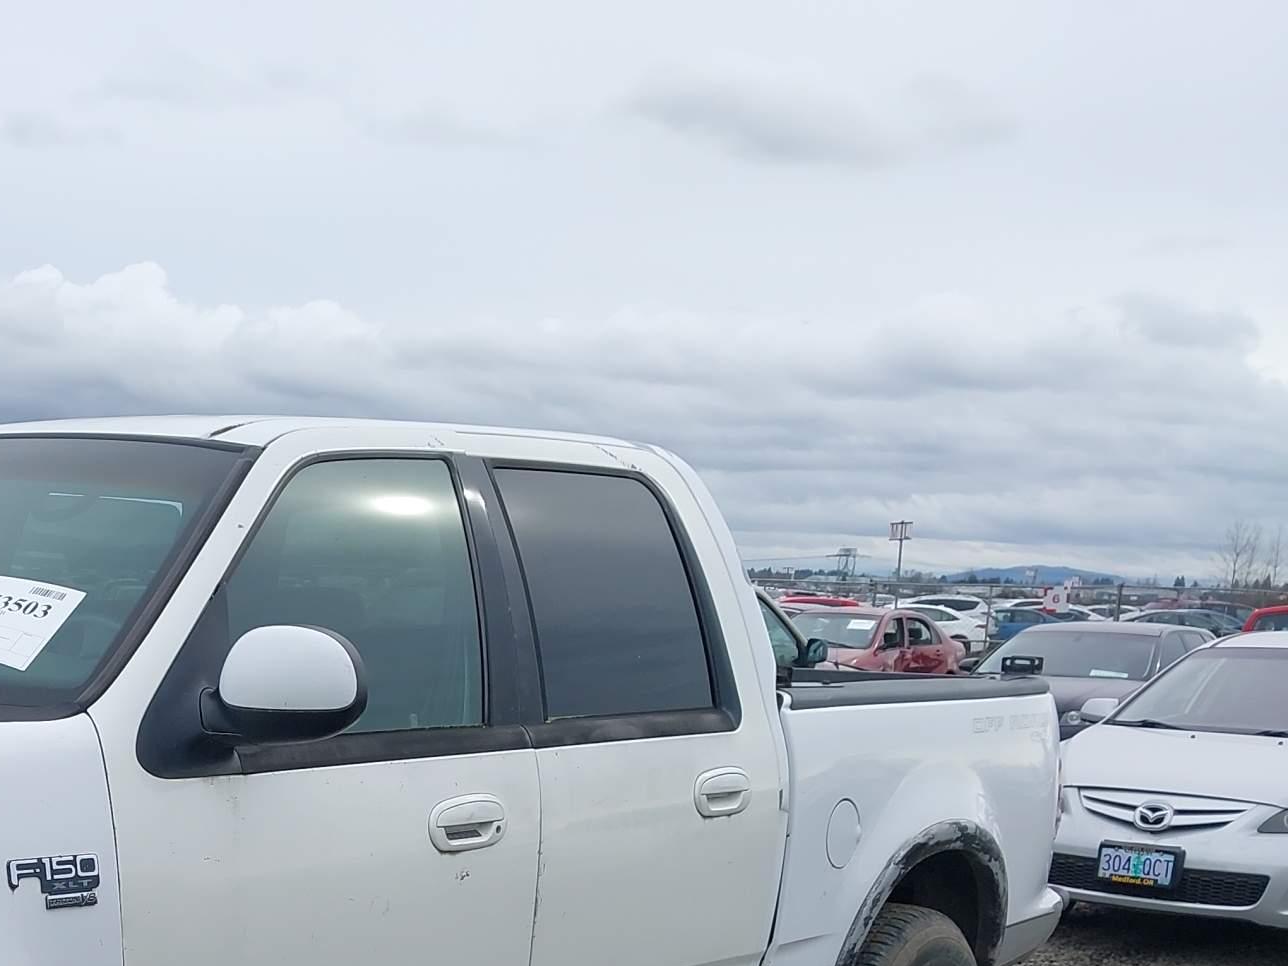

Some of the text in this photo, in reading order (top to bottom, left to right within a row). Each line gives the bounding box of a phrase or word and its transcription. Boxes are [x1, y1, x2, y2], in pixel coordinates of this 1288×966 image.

[1101, 853, 1174, 878] 304 QCT
[52, 880, 92, 890] XLT
